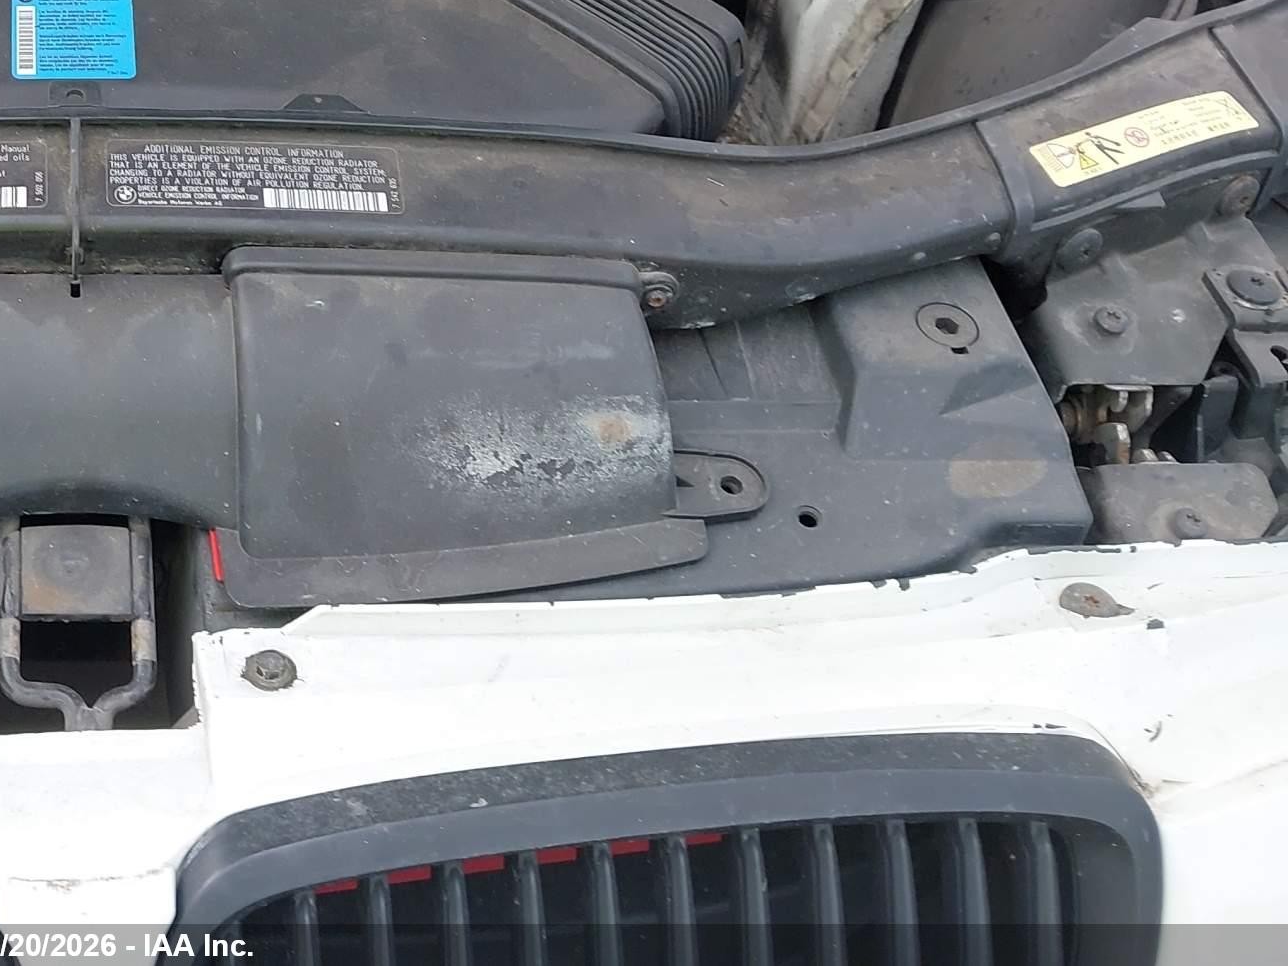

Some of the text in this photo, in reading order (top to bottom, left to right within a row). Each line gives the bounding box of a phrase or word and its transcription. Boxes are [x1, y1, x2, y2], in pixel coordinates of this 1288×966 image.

[1, 144, 30, 153] Manual
[144, 144, 344, 158] ADDITIONAL EMISSION CONTROL INFORMATION
[13, 153, 30, 161] oils
[110, 153, 128, 161] THIS
[132, 153, 165, 162] VEHICLE
[182, 154, 220, 163] EQUIPPED
[224, 155, 244, 163] WITH
[248, 155, 260, 163] AN
[263, 156, 288, 165] OZONE
[292, 157, 335, 166] REDUCTION
[338, 159, 378, 167] RADIATOR
[109, 161, 130, 169] THAT
[134, 161, 143, 169] IS
[147, 161, 159, 169] AN
[162, 161, 198, 170] ELEMENT
[202, 162, 211, 170] OF
[217, 162, 231, 170] THE
[236, 163, 269, 172] VEHICLE
[273, 164, 311, 173] EMISSION
[314, 165, 349, 174] CONTROL
[109, 169, 148, 177] CHANGING
[177, 169, 217, 178] RADIATOR
[221, 170, 255, 179] WITHOUT
[260, 172, 309, 181] EQUIVALENT
[313, 173, 338, 182] OZONE
[342, 174, 385, 184] REDUCTION
[109, 176, 157, 185] PROPERTIES
[162, 177, 170, 185] IS
[174, 177, 180, 185] A
[185, 177, 229, 186] VIOLATION
[232, 178, 241, 186] OF
[247, 178, 261, 187] AIR
[265, 179, 310, 188] POLLUTION
